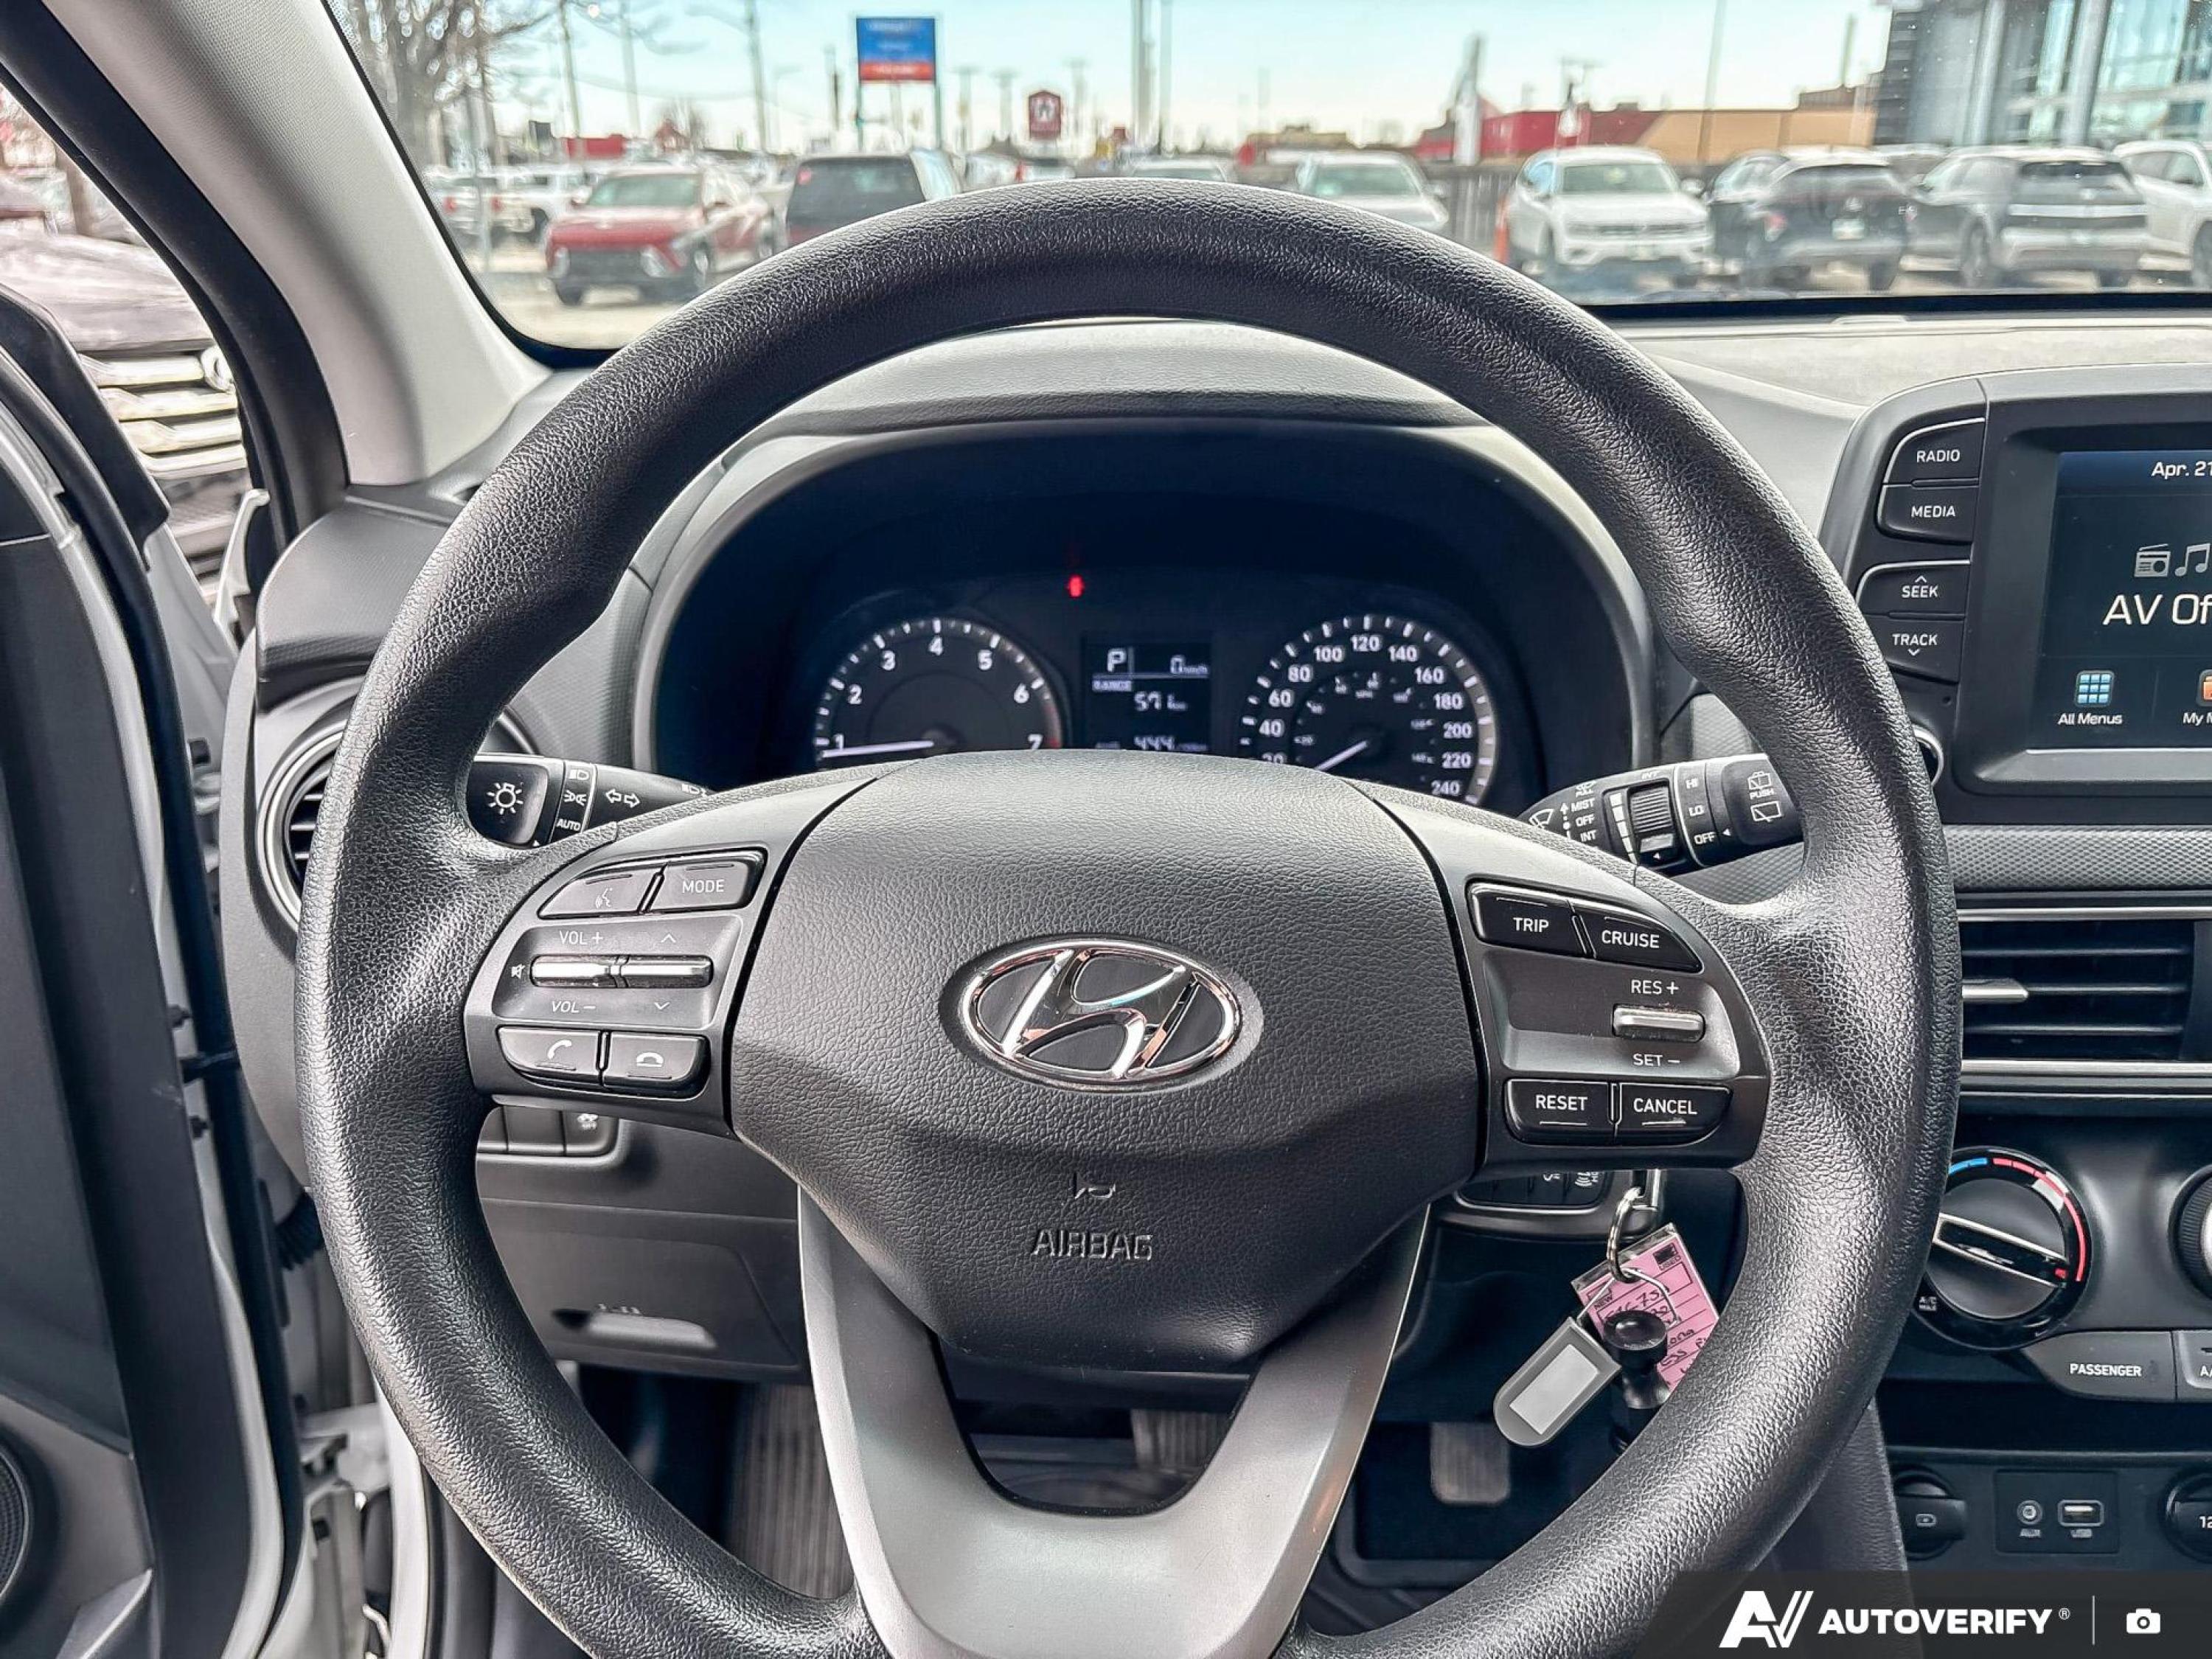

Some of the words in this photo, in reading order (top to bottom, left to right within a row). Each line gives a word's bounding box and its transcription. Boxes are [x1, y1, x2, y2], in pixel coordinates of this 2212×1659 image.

[1916, 449, 1961, 463] RADIO
[2151, 462, 2190, 480] Apr.
[1911, 505, 1955, 518] MEDIA
[1902, 585, 1938, 599] SEEK
[2102, 594, 2163, 625] AV
[929, 636, 944, 655] 4
[1351, 634, 1383, 652] 120
[1893, 633, 1938, 647] TRACK
[881, 650, 896, 670] 3
[978, 649, 992, 670] 5
[1107, 648, 1127, 672] P
[1313, 645, 1344, 662] 100
[1388, 645, 1419, 662] 140
[1287, 665, 1313, 683] 80
[1415, 667, 1445, 684] 160
[848, 684, 863, 705] 2
[1014, 684, 1030, 704] 6
[1268, 689, 1294, 707] 60
[1434, 692, 1465, 710] 180
[2058, 712, 2075, 725] All
[2078, 712, 2122, 725] Menus
[2183, 712, 2204, 726] My
[1259, 719, 1285, 737] 40
[1443, 721, 1474, 739] 200
[834, 734, 844, 749] 1
[1028, 734, 1043, 750] 7
[1441, 751, 1472, 768] 220
[1641, 772, 1659, 780] INT
[1430, 780, 1461, 796] 240
[1749, 787, 1774, 800] PUSH
[1571, 799, 1596, 813] MIST
[1688, 804, 1705, 816] LO
[557, 818, 581, 831] AUTO
[1576, 814, 1595, 827] OFF
[1580, 830, 1596, 842] INT
[1694, 831, 1715, 845] OFF
[682, 879, 725, 894] MODE
[1513, 917, 1549, 933] TRIP
[1601, 930, 1660, 949] CRUISE
[1535, 1096, 1587, 1111] RESET
[1633, 1098, 1697, 1115] CANCEL
[1031, 1229, 1154, 1261] AIRBAG
[2070, 1363, 2142, 1377] PASSENGER
